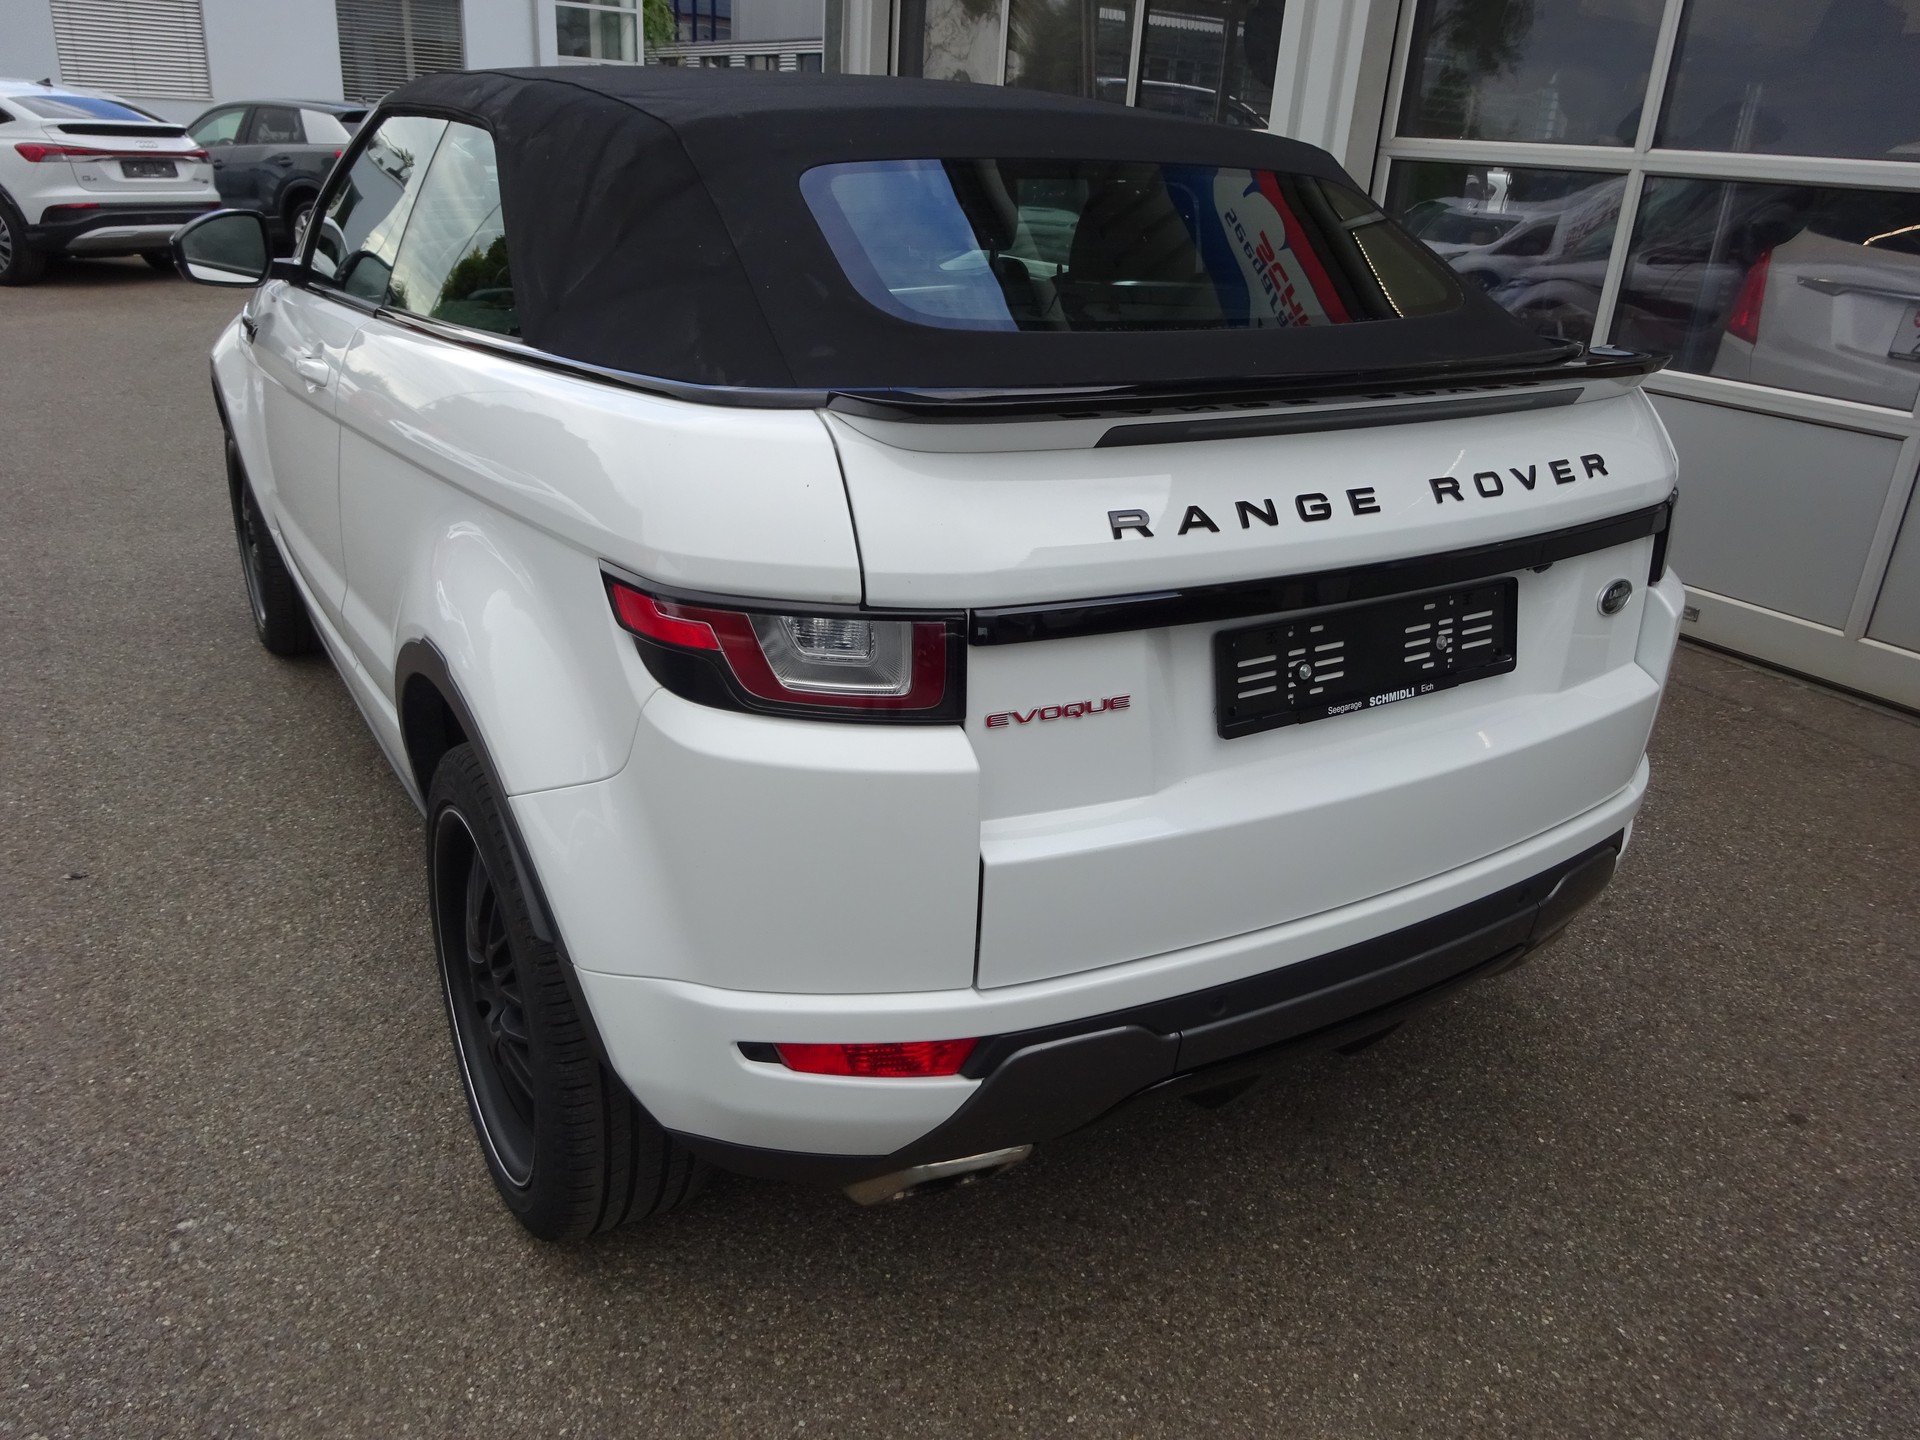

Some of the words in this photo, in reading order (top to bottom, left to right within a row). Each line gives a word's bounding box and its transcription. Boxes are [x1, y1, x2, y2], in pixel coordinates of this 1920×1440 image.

[1108, 487, 1381, 540] RANGE
[1429, 453, 1609, 504] ROVER
[984, 694, 1131, 729] EVOQUE
[1328, 701, 1362, 715] Seegarage
[1369, 687, 1415, 707] SCHMIDLI
[1421, 683, 1434, 693] Eich
